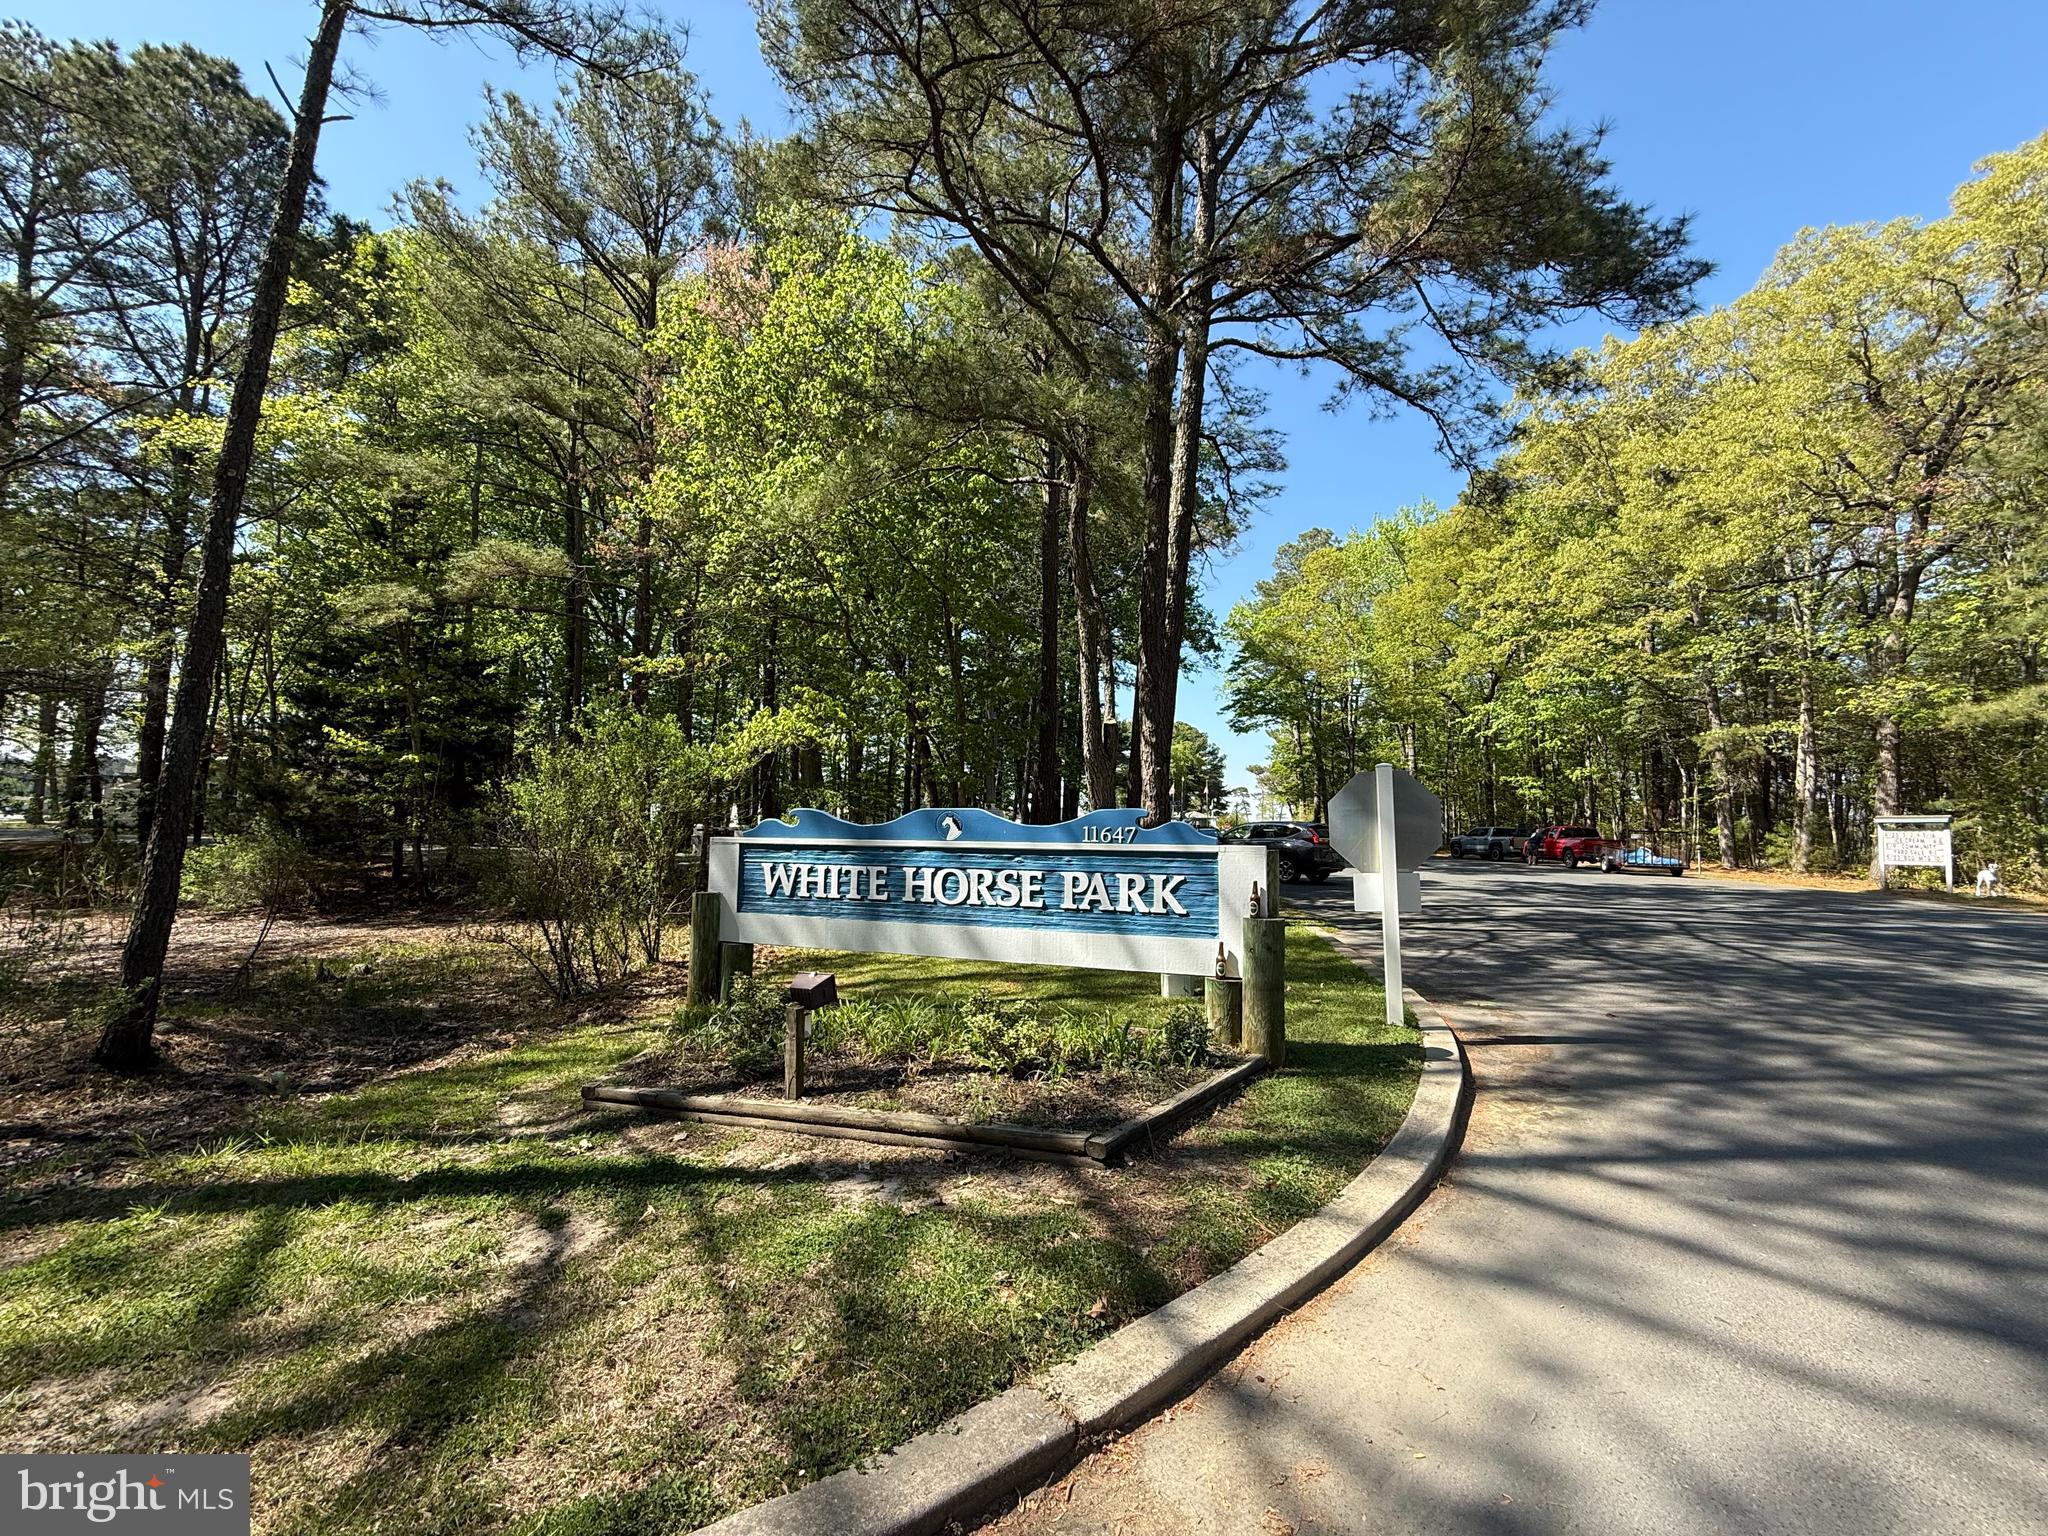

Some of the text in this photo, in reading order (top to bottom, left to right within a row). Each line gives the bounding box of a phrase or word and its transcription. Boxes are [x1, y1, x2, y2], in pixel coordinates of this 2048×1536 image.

[1082, 826, 1136, 844] 11647
[761, 862, 1188, 915] WHITE HORSE PARK
